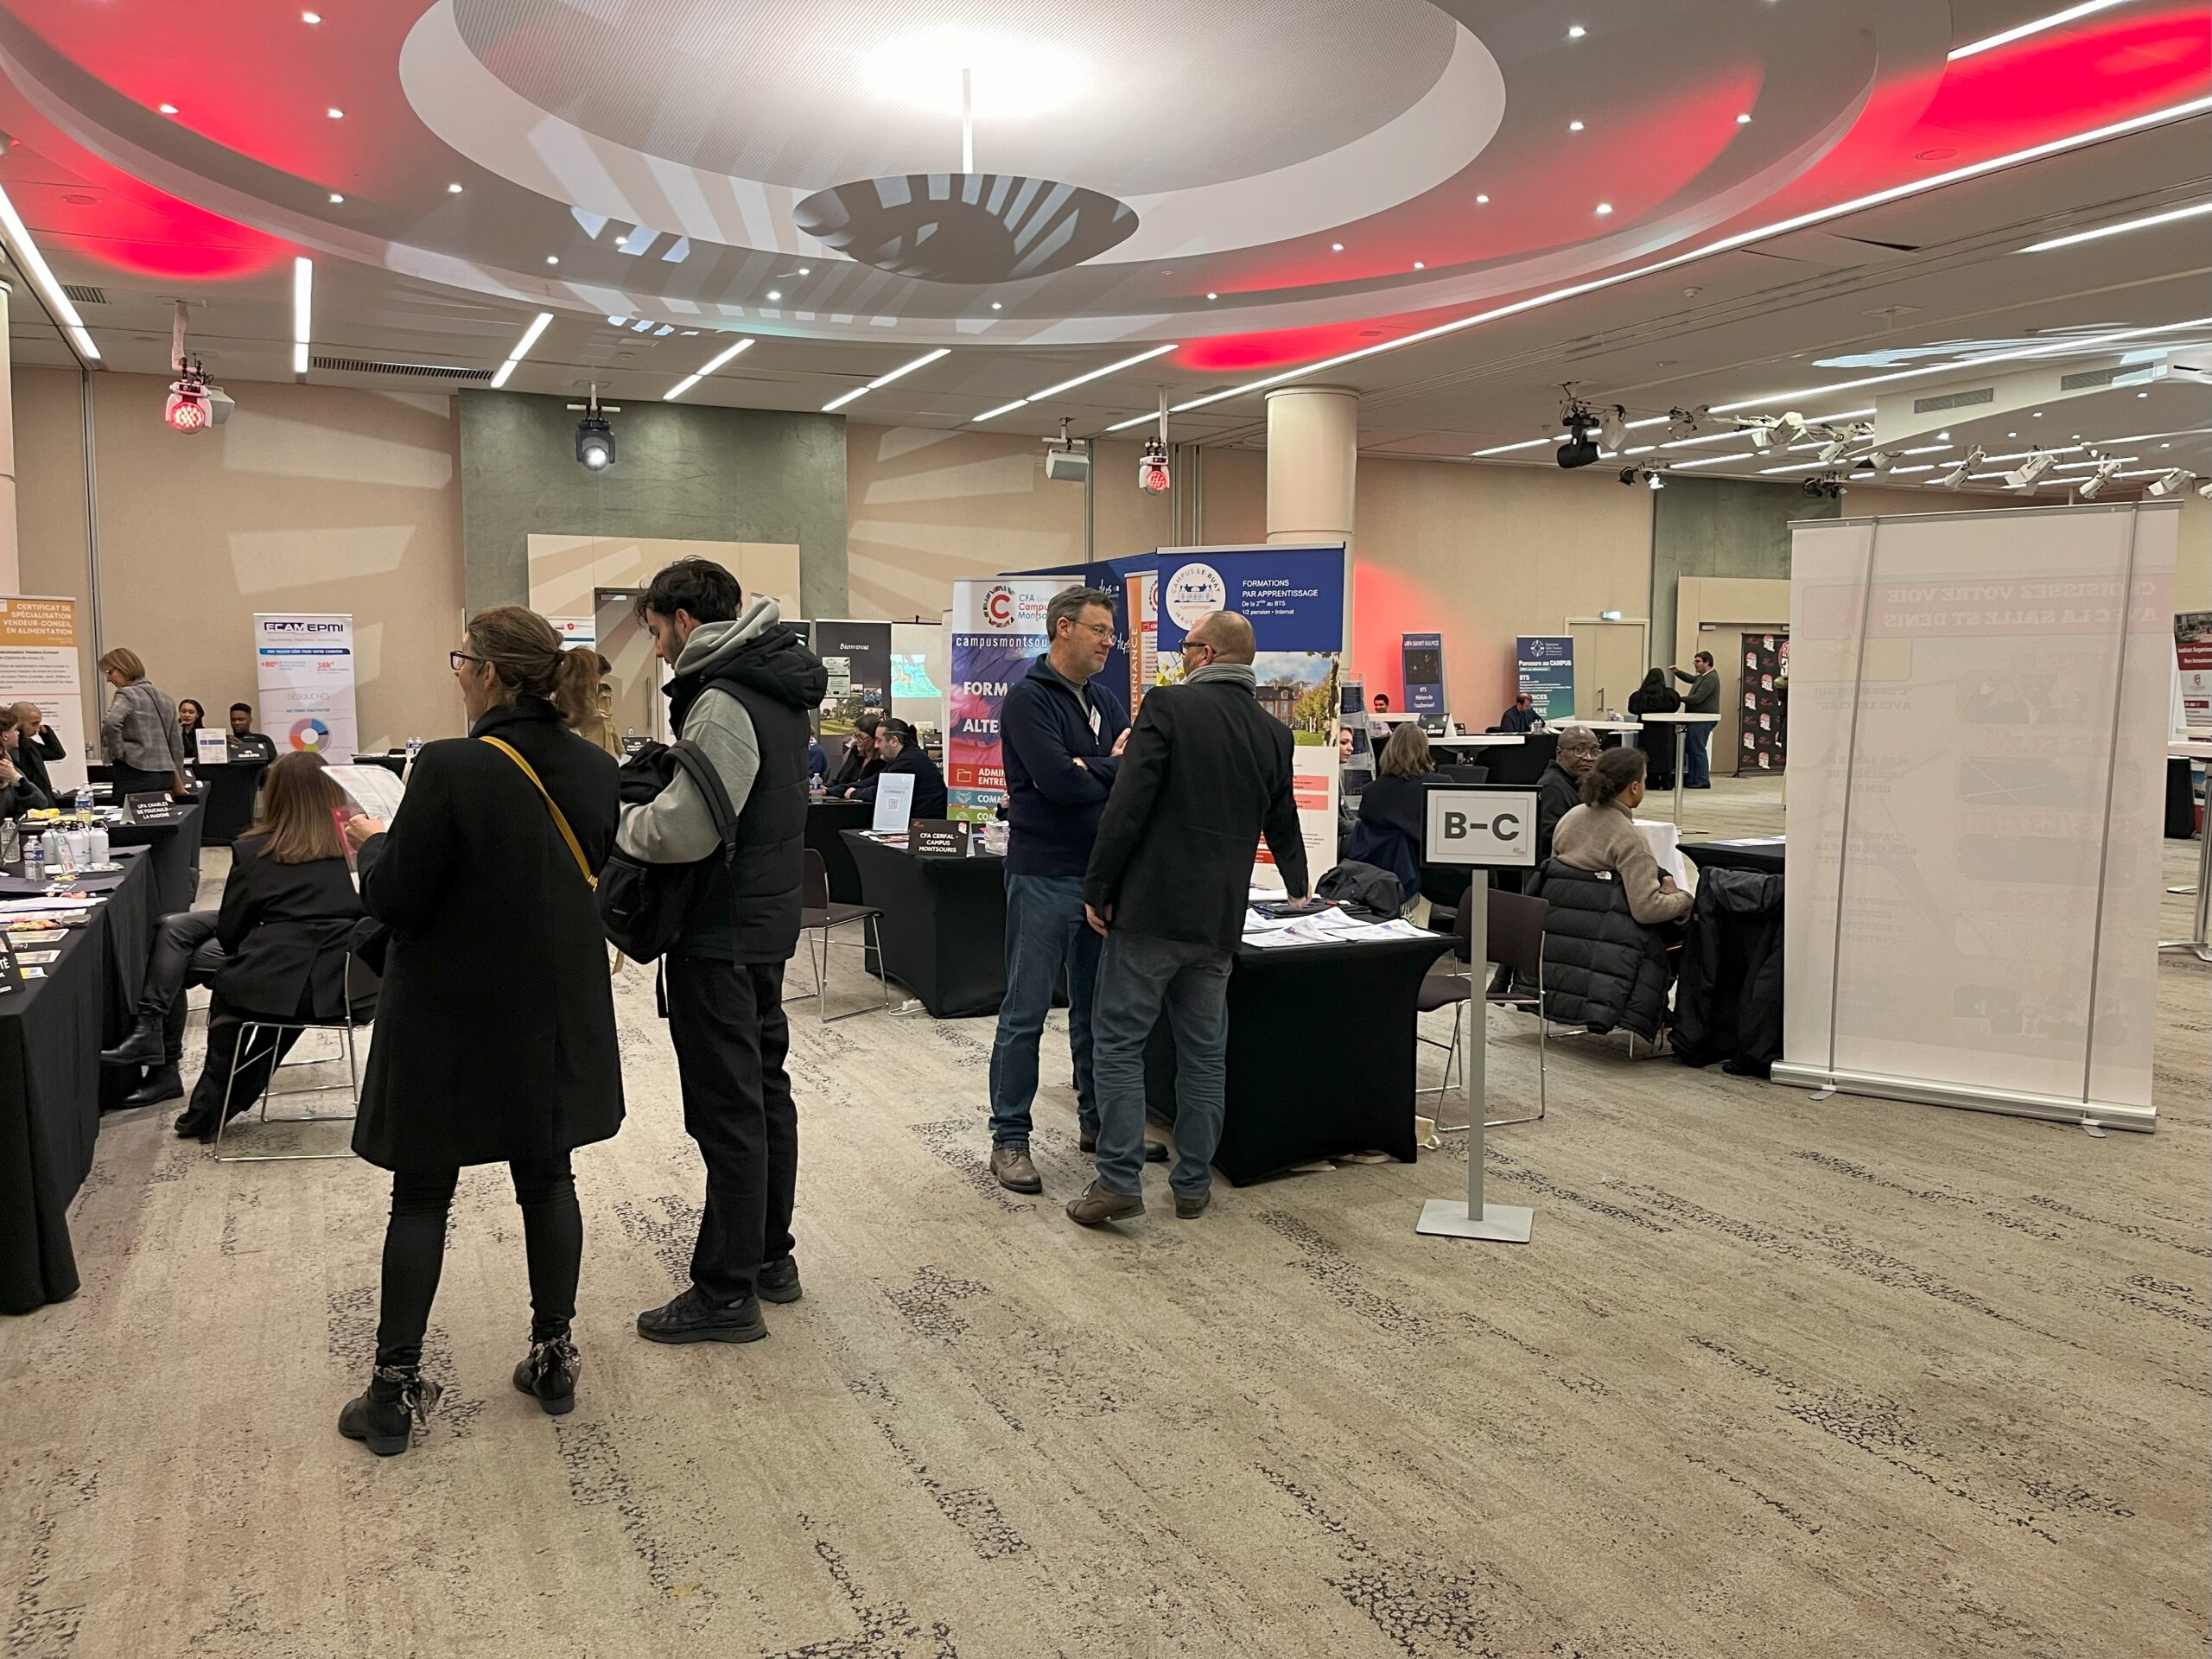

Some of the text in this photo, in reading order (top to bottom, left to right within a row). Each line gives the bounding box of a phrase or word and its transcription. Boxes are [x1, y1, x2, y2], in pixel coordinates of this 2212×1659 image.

[1172, 569, 1195, 593] CAMPUS
[1207, 573, 1221, 592] BUAT
[1259, 589, 1319, 598] APPRENTISSAGE
[11, 611, 72, 620] SPÉCIALISATION
[1175, 611, 1194, 626] MAUL
[265, 623, 304, 632] ECAM
[956, 637, 1049, 649] campusmontsou
[963, 682, 1008, 696] FORM
[963, 719, 999, 734] ALTE
[978, 768, 1006, 778] ADMIN
[978, 777, 1007, 786] ENTRE
[976, 812, 995, 822] COM
